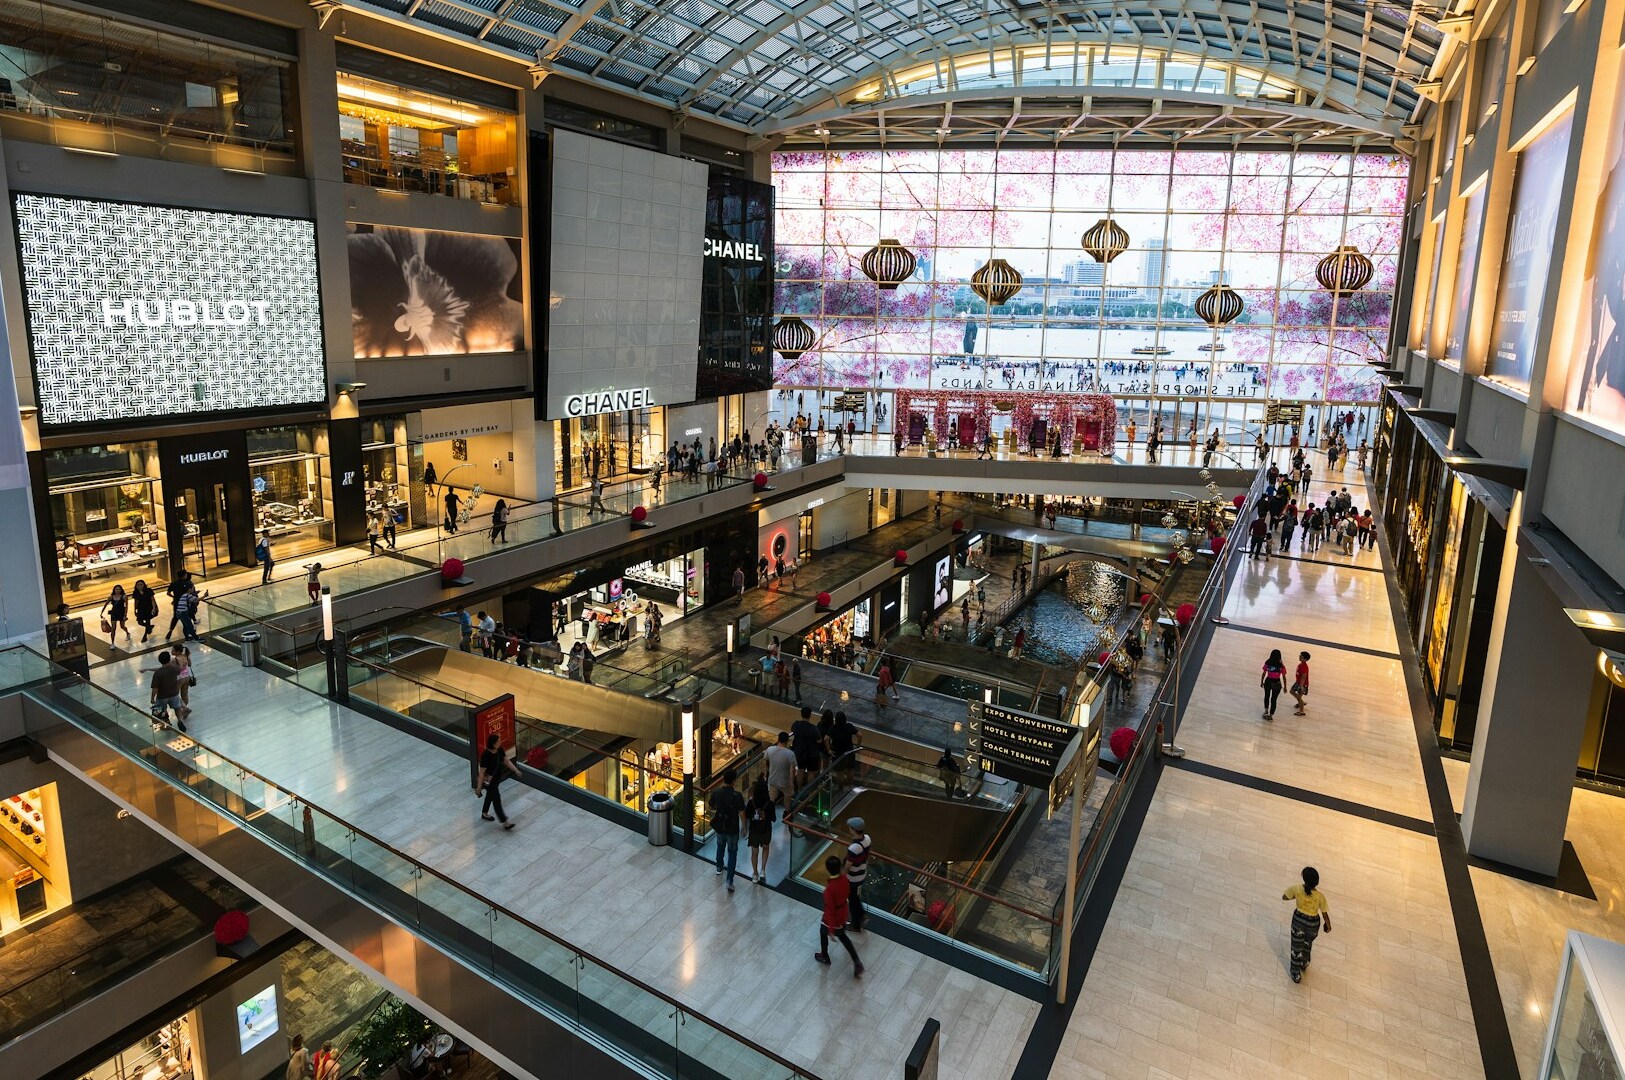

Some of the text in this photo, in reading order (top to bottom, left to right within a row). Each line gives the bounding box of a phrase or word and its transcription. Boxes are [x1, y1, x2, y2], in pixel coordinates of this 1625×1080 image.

[703, 238, 763, 261] CHANEL
[101, 299, 270, 327] HUBLOT
[566, 388, 655, 416] CHANEL
[425, 430, 458, 439] GARDENS
[180, 450, 229, 464] HUBLOT
[625, 560, 653, 575] CHANEL
[984, 707, 1005, 718] EXPO
[1014, 716, 1068, 734] CONVENTION
[984, 725, 1008, 737] HOTEL
[1018, 734, 1053, 749] SKYPARK
[983, 742, 1008, 754] COACH
[1011, 750, 1051, 767] TERMINAL
